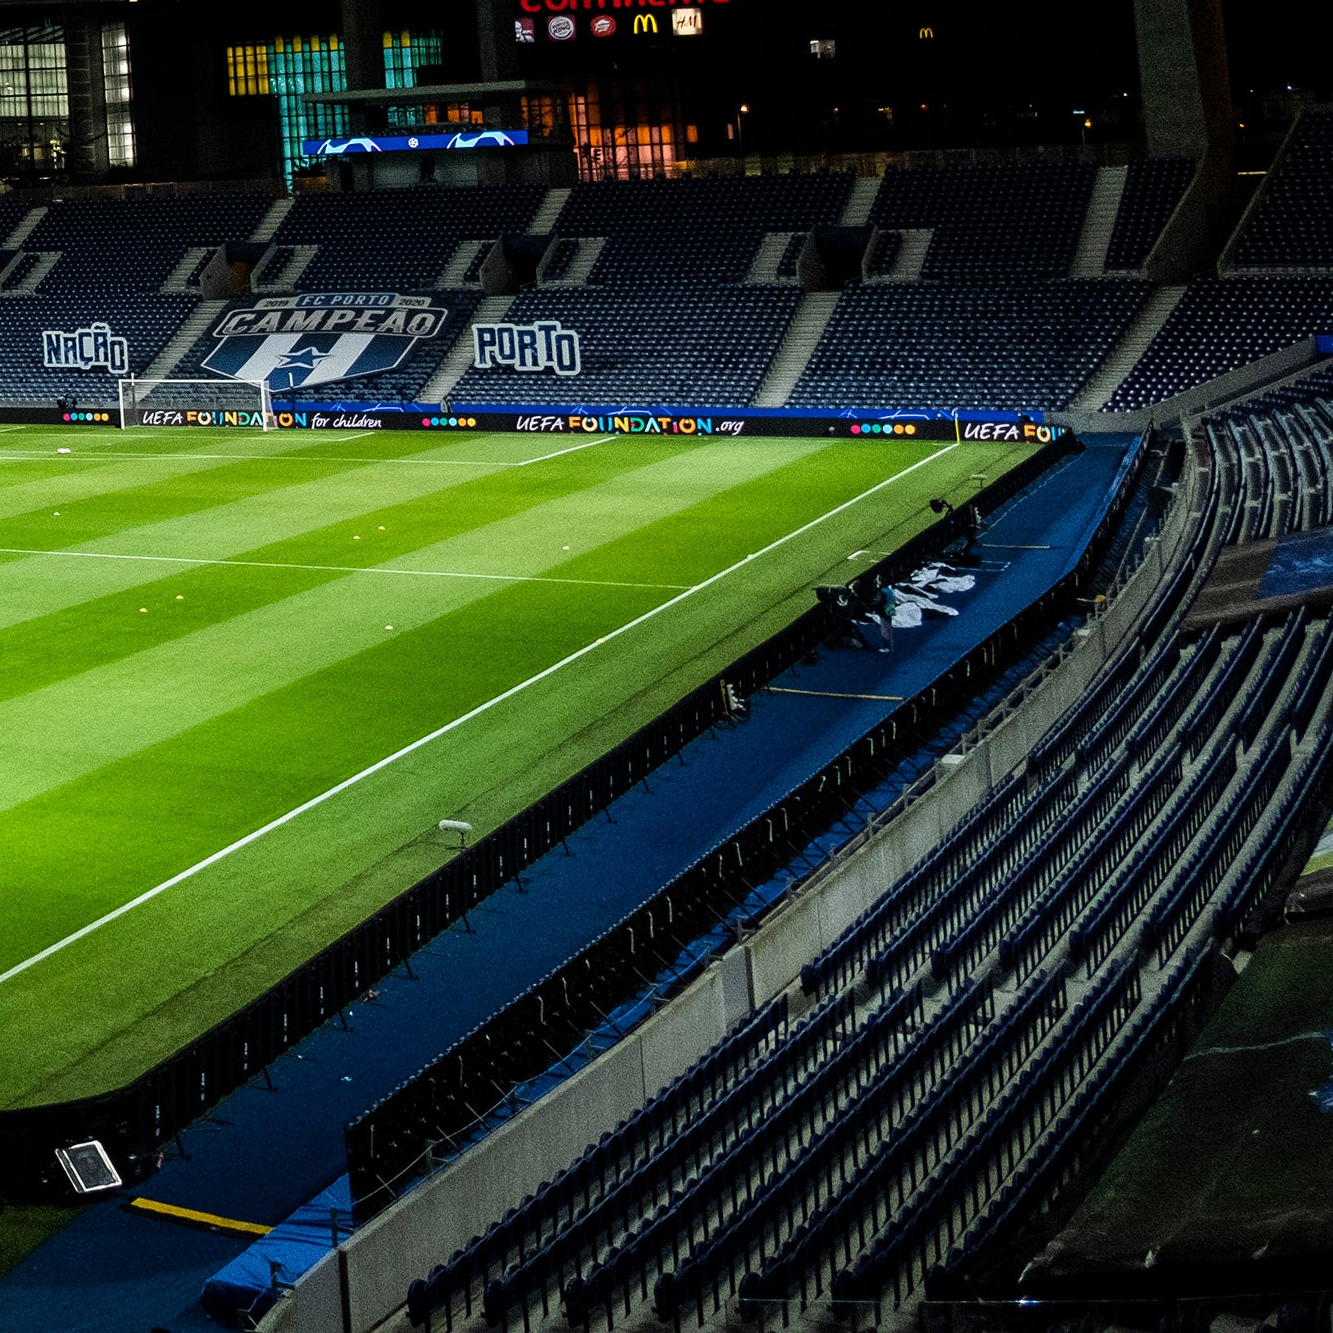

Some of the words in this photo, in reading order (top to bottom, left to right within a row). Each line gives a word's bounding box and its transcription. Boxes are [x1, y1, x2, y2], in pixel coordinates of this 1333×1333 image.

[263, 300, 289, 308] 2019
[301, 295, 326, 306] FC
[330, 295, 390, 306] PORTO
[398, 299, 425, 307] 2020
[223, 308, 434, 335] CAMPEÃO
[44, 324, 127, 372] NAÇÃO
[475, 322, 578, 373] PORTO
[143, 411, 183, 426] UEFA
[311, 412, 330, 429] for
[332, 413, 382, 428] children
[516, 416, 564, 432] UEFA
[568, 416, 713, 434] FOUNDATION
[964, 422, 1020, 441] UEFA
